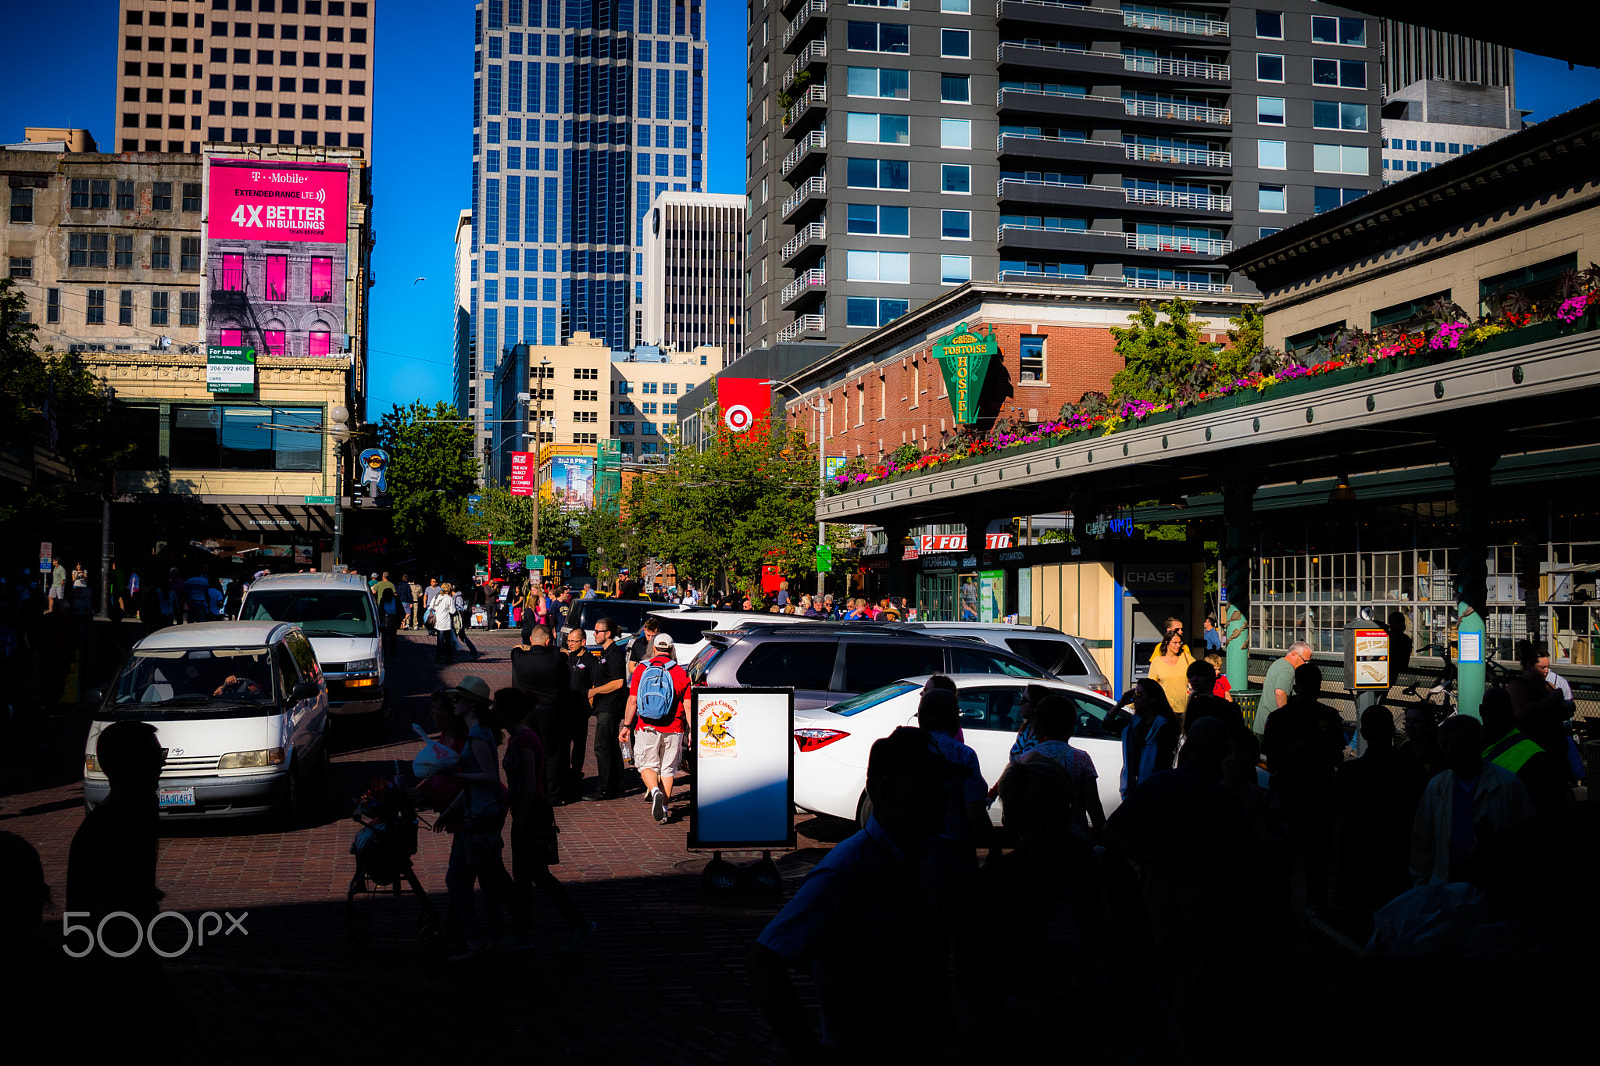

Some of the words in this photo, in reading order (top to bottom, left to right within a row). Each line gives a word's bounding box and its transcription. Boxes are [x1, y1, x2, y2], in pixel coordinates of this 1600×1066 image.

[235, 189, 274, 198] EXTENDED
[275, 191, 300, 199] RANGE
[231, 204, 263, 228] 4X
[266, 205, 325, 221] BETTER
[277, 220, 325, 229] BUILDINGS
[952, 334, 978, 345] GREEN
[942, 344, 987, 356] TORTOISE
[957, 356, 968, 423] HOSTEL
[1110, 518, 1125, 532] ATM
[924, 536, 936, 549] 2
[1127, 572, 1174, 583] CHASE
